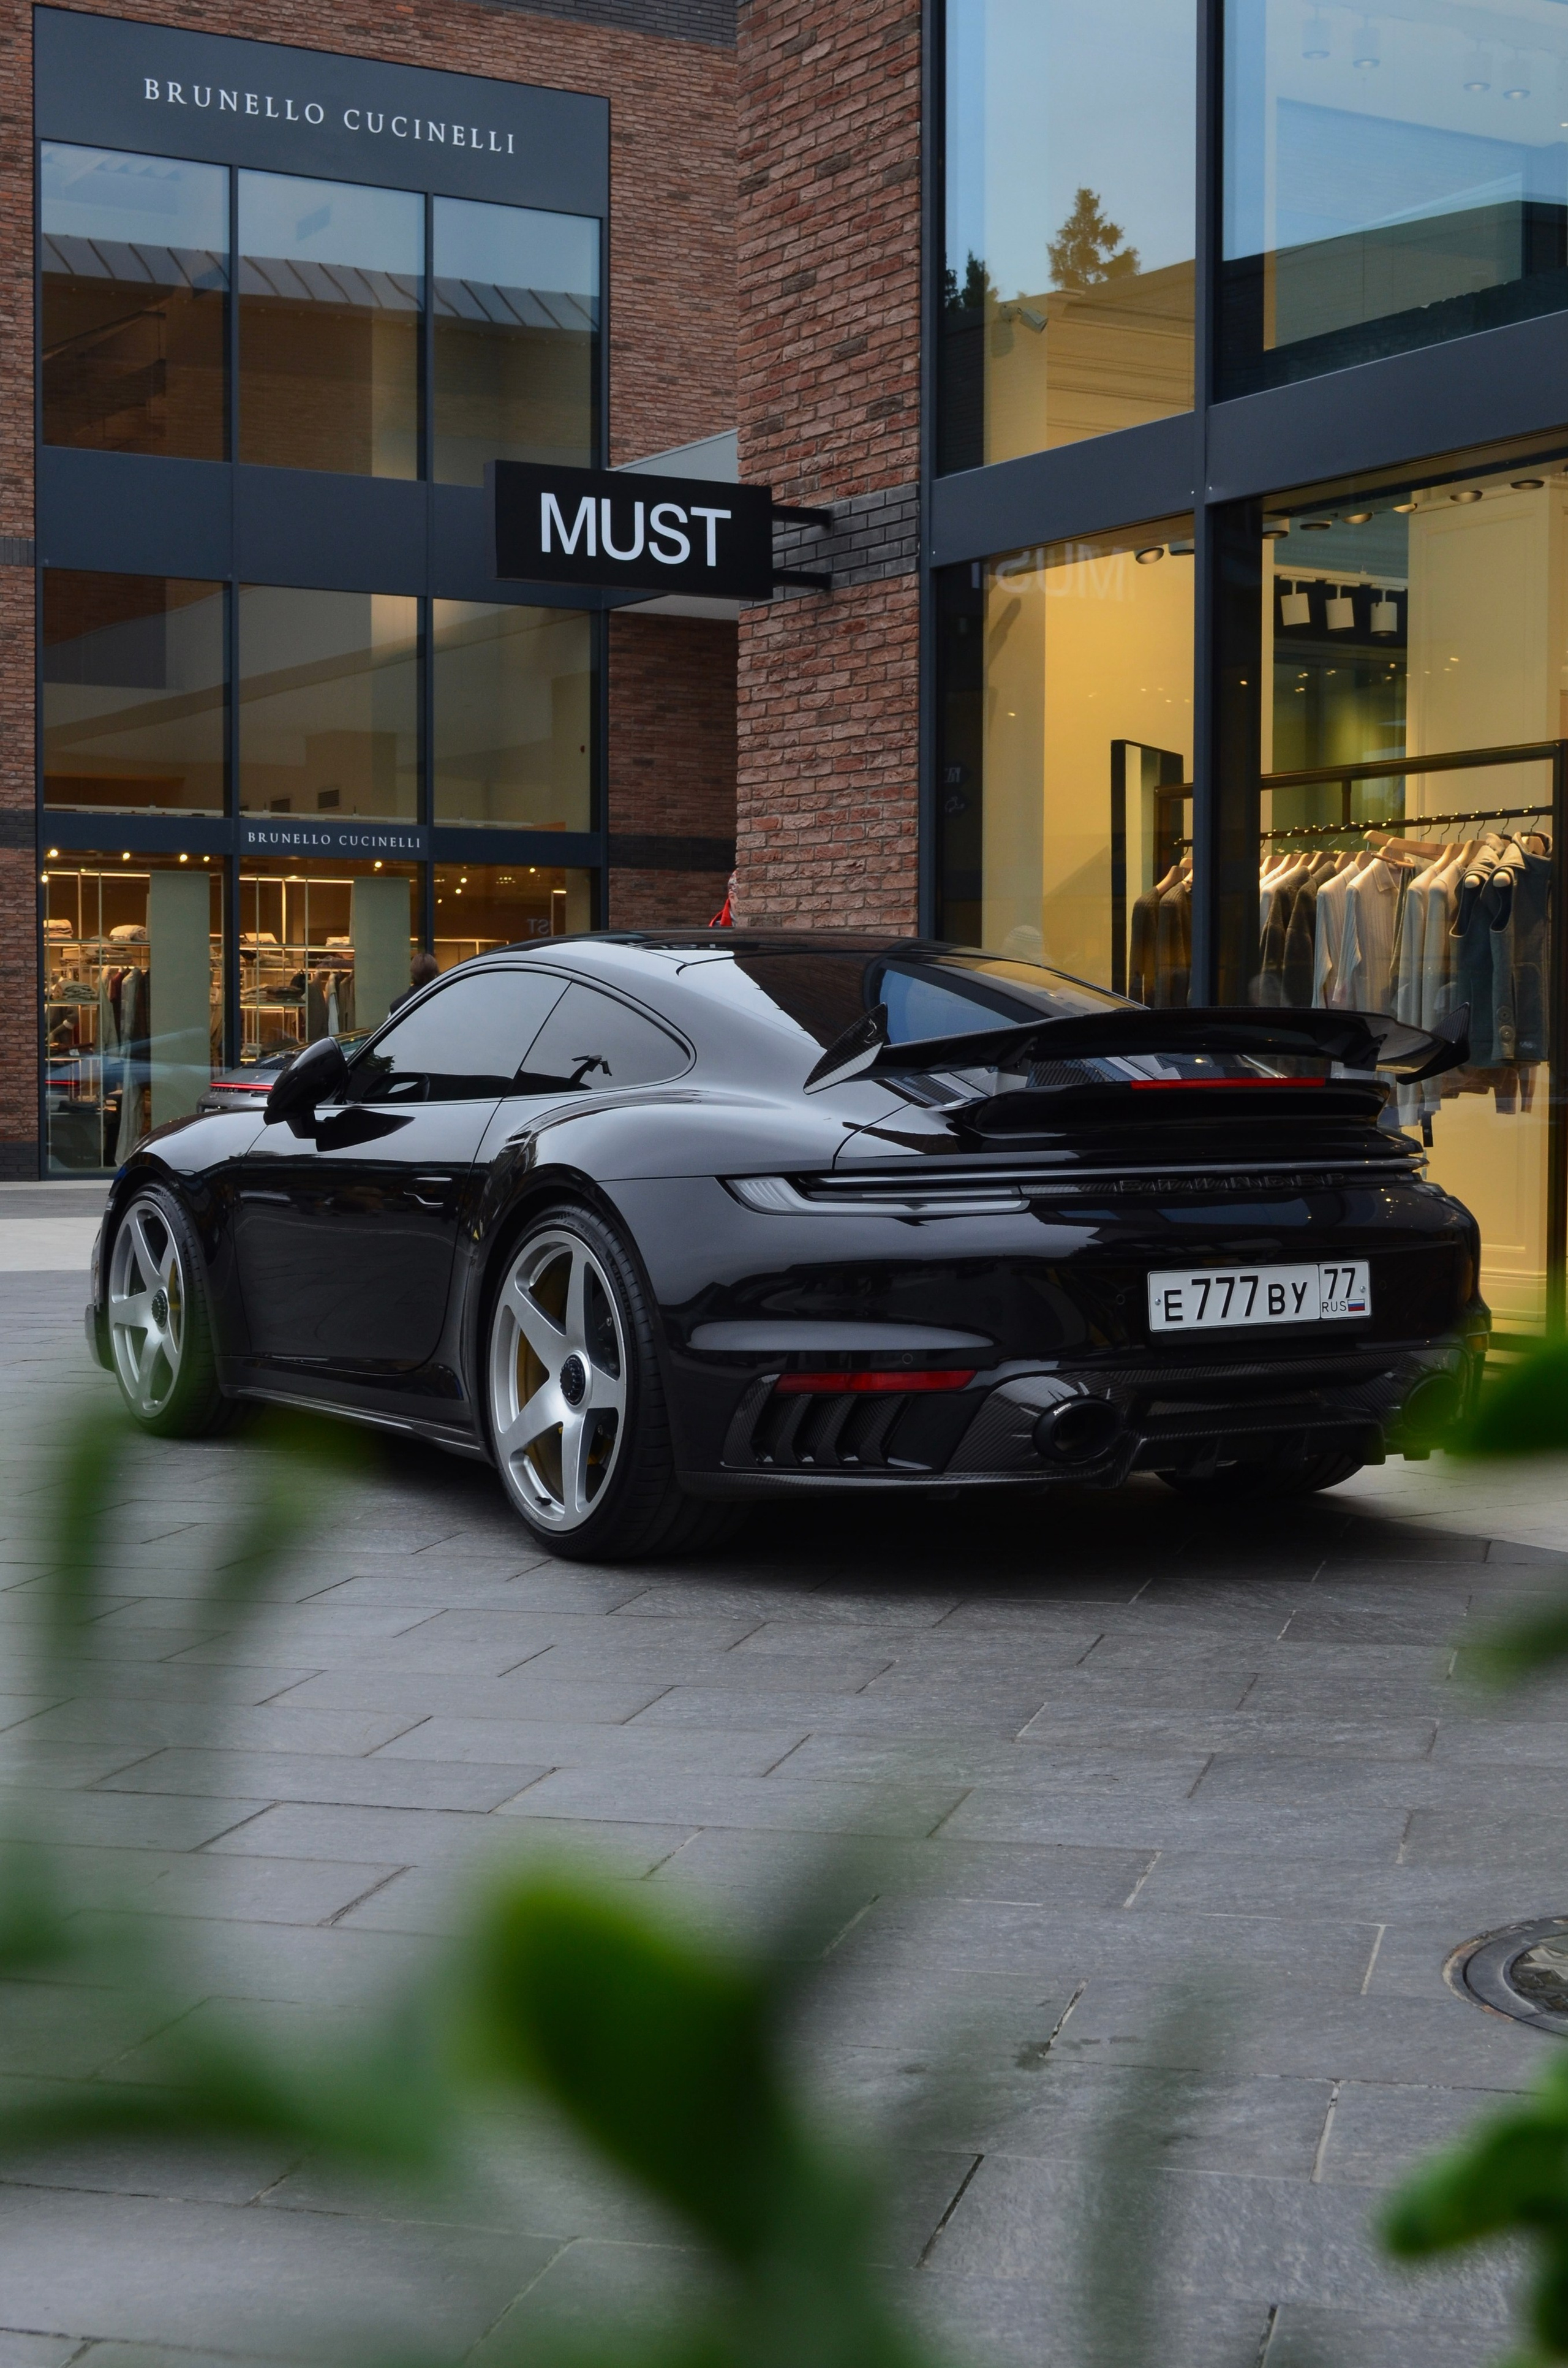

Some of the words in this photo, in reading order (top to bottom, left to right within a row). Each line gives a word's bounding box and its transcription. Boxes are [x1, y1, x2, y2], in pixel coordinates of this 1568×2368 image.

[144, 78, 325, 124] BRUNELLO
[344, 109, 514, 154] CUCINELLI
[541, 493, 731, 566] MUST
[248, 832, 331, 845] BRUNELLO
[339, 835, 420, 848] CUCINELLI
[1324, 1267, 1355, 1299] 77
[1322, 1300, 1347, 1313] RUS
